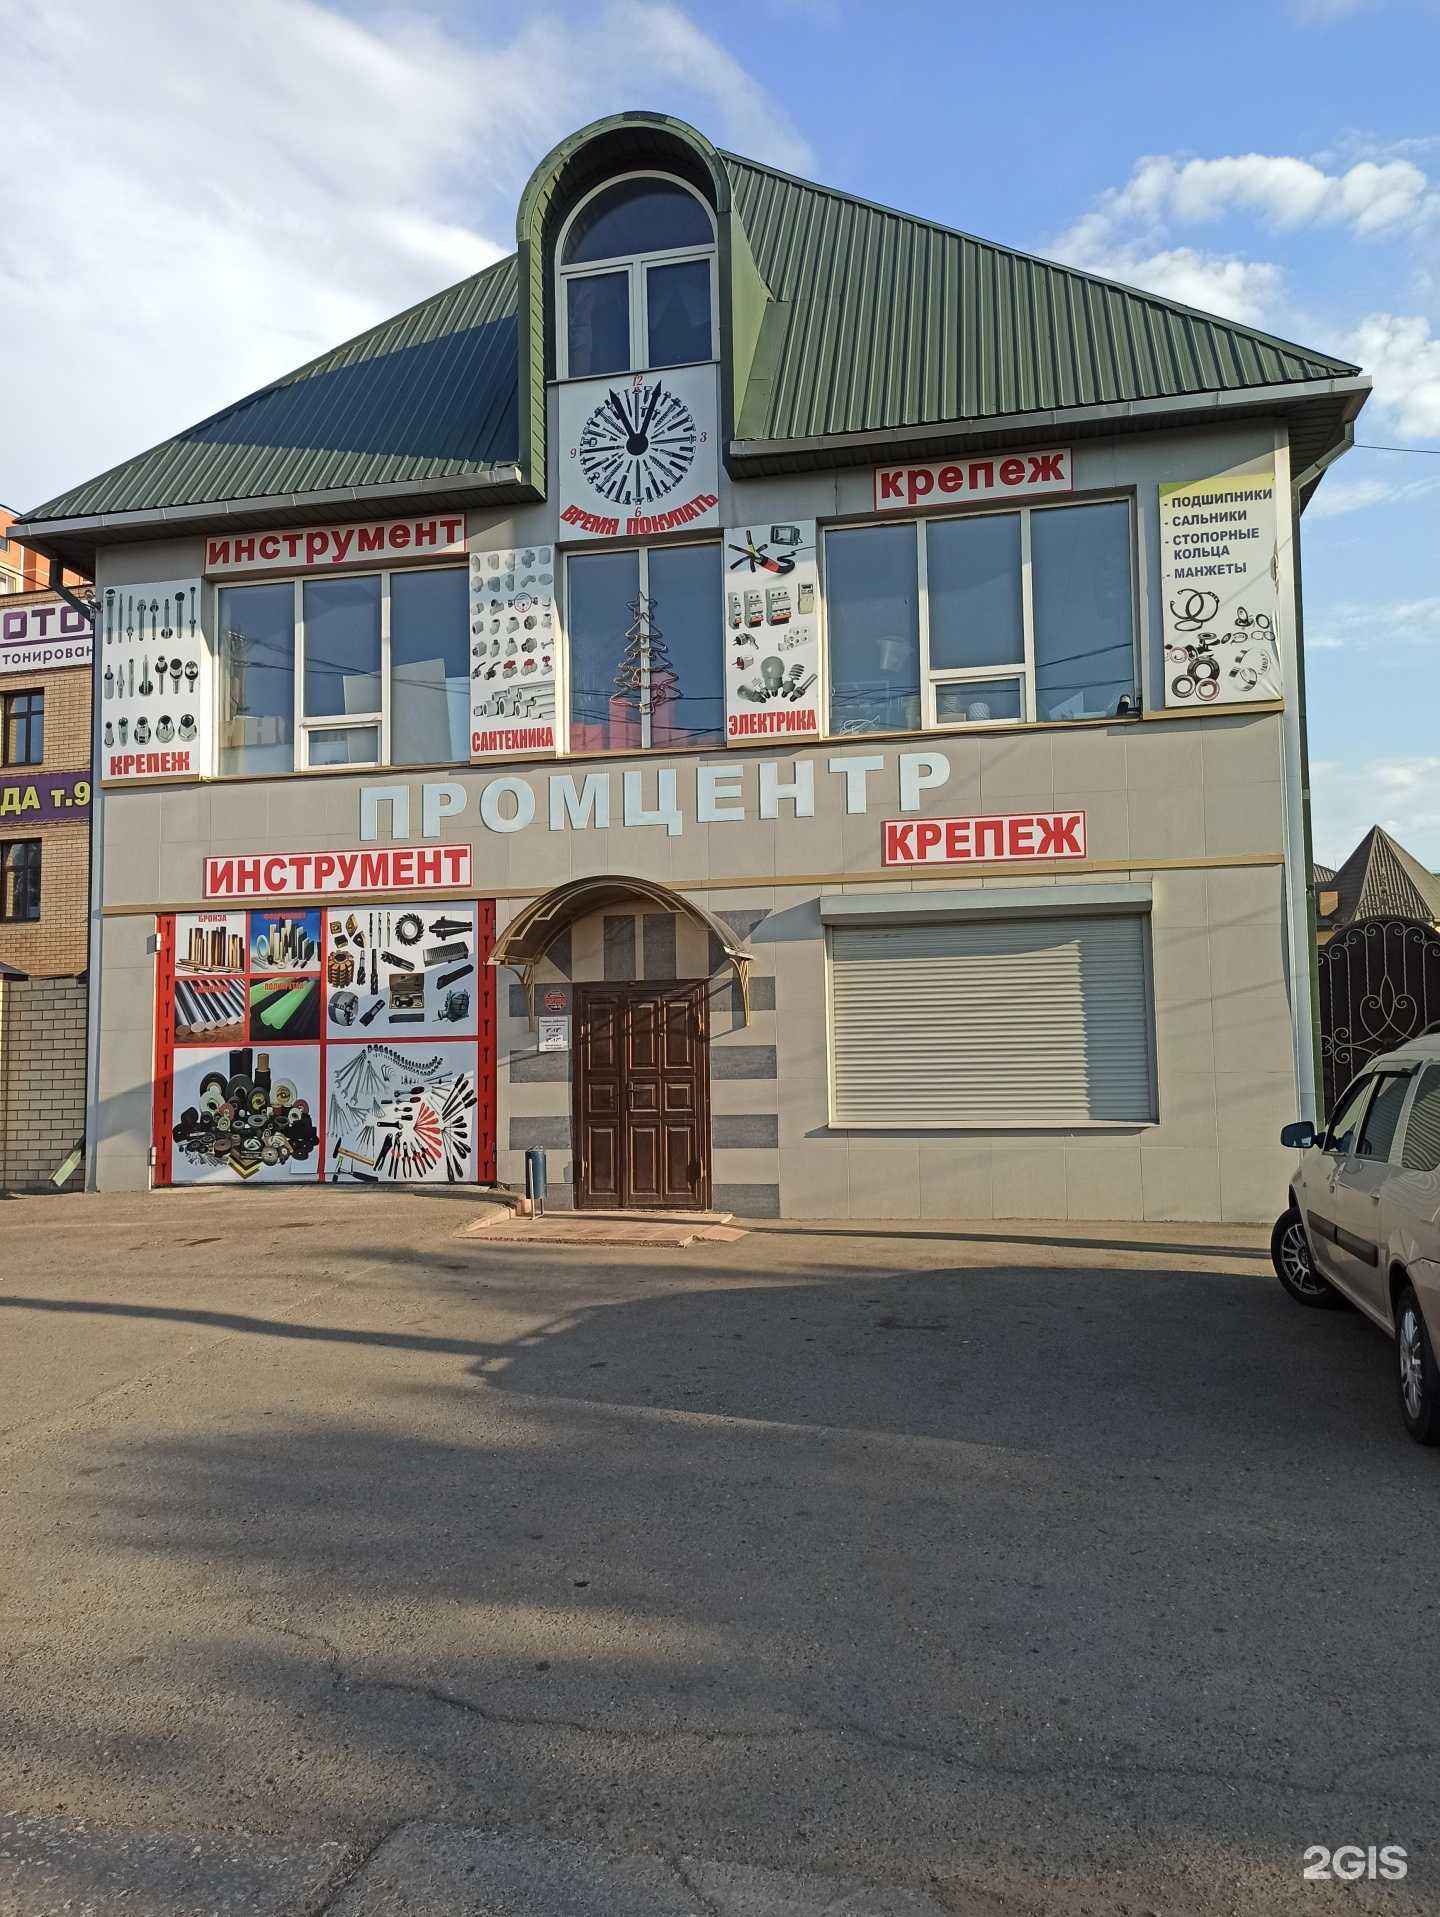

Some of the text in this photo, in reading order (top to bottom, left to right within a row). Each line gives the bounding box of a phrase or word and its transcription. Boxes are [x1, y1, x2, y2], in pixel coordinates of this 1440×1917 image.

[632, 375, 643, 387] 12
[700, 432, 708, 443] 3
[570, 448, 577, 459] 9
[881, 454, 1065, 504] крепеж
[1172, 489, 1272, 508] ПОДШИПНИКИ
[560, 494, 719, 535] ВРЕМЯ ПОКУПАТЬ
[634, 506, 642, 518] 6
[1172, 510, 1247, 527] САЛЬНИКИ
[208, 519, 462, 564] инструмент
[1173, 528, 1259, 546] СТОПОРНЫЕ
[1174, 545, 1230, 560] КОЛЬЦА
[1174, 562, 1247, 579] МАНЖЕТЫ
[728, 709, 817, 736] ЭЛЕКТРИКА
[472, 727, 554, 752] САНТЕХНИКА
[110, 751, 190, 776] КРЕПЕЖ
[0, 786, 40, 816] ДА
[360, 752, 951, 840] ПРОМЦЕНТР
[888, 815, 1082, 861] КРЕПЕЖ
[210, 849, 468, 894] ИНСТРУМЕНТ
[198, 914, 227, 923] БРОНЗА
